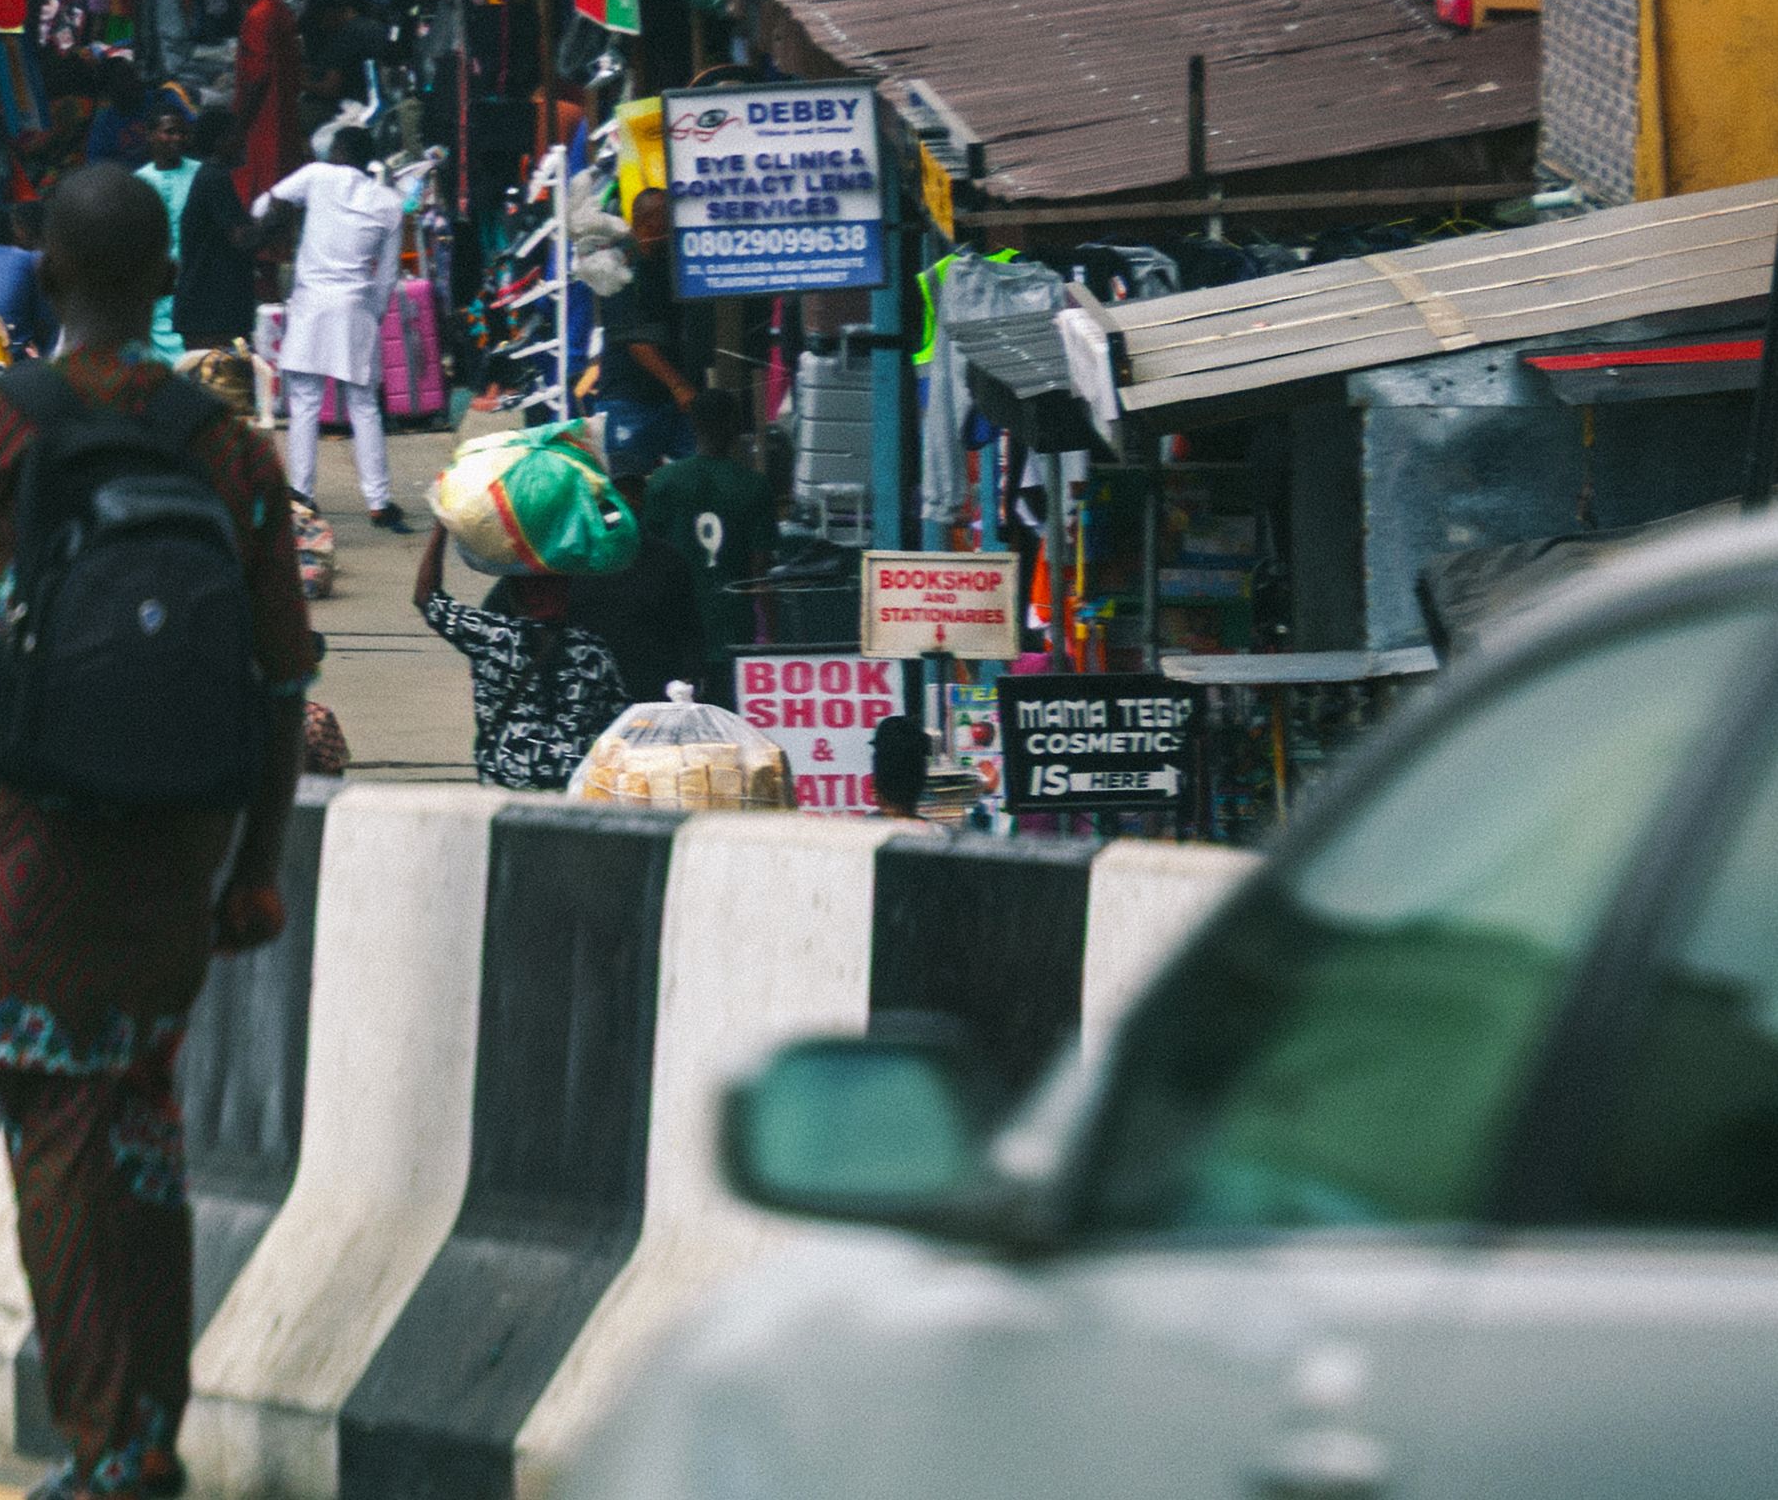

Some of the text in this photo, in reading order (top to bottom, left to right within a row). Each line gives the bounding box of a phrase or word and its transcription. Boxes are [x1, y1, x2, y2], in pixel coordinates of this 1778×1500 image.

[747, 98, 860, 125] DEBBY
[695, 148, 866, 175] EYE CLINIC &
[670, 175, 795, 198] CONTACT
[705, 195, 841, 221] SERVICES
[683, 224, 867, 257] 08029099638
[694, 510, 725, 568] 9
[878, 569, 1003, 592] BOOKSHOP
[922, 593, 958, 604] AND
[878, 607, 1006, 625] STATIONARIES
[744, 660, 894, 695] BOOK
[744, 698, 894, 730] SHOP
[1017, 700, 1108, 729] MAMA
[810, 737, 835, 763] &
[1029, 764, 1151, 797] IS HERE
